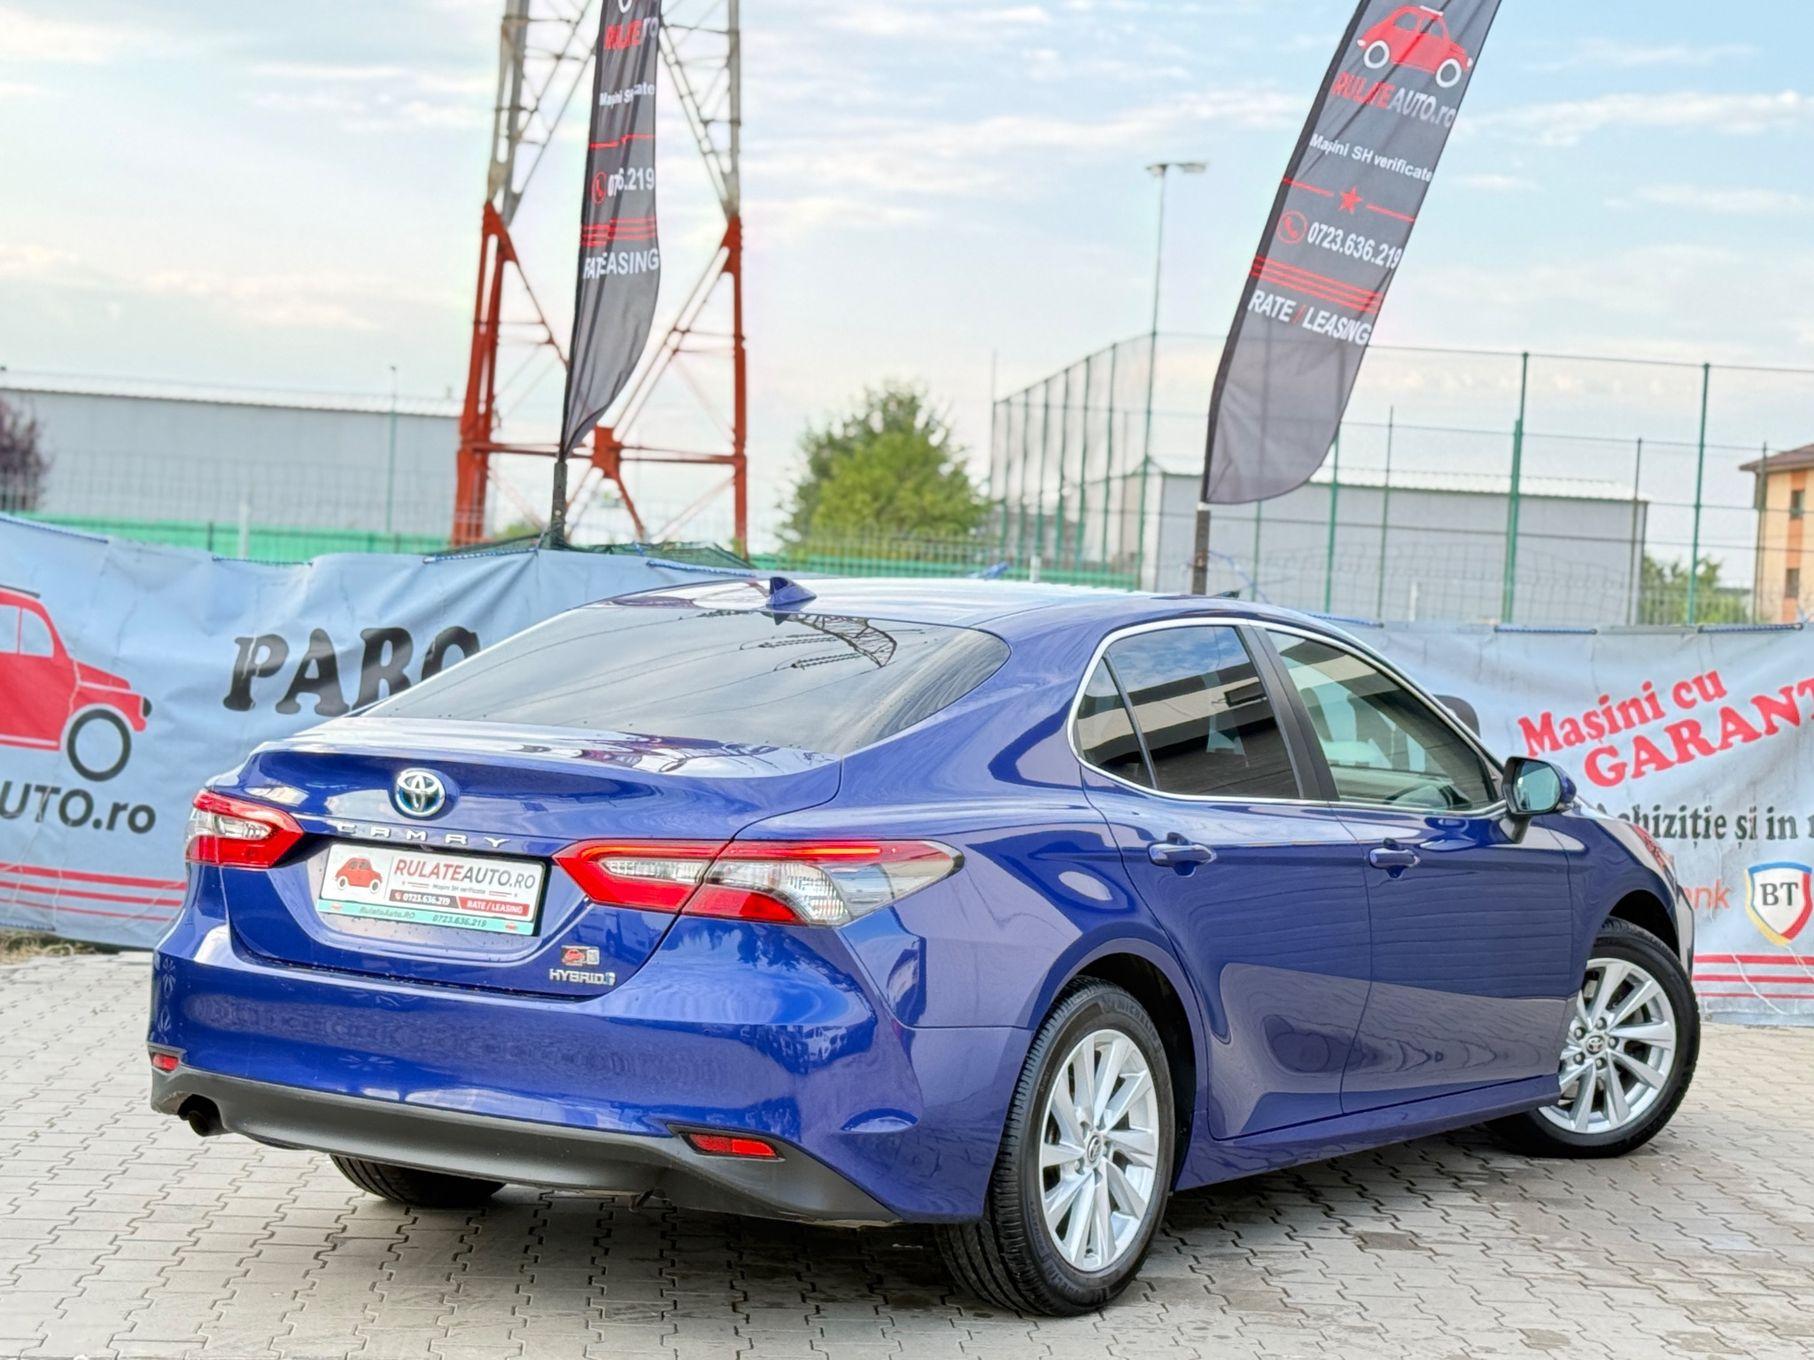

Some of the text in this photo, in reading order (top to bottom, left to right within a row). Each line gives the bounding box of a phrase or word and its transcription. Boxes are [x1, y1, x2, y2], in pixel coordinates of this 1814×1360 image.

[1351, 145, 1374, 164] SH
[1374, 153, 1433, 182] verificate
[1307, 221, 1402, 269] 0723.636.219
[1248, 290, 1297, 322] RATE
[1302, 306, 1372, 346] LEASING
[1672, 669, 1728, 710] cu
[337, 822, 511, 848] CAMRY
[1766, 806, 1799, 840] in
[394, 859, 536, 890] RULATEAUTO.RO
[1760, 881, 1799, 907] BT
[549, 968, 602, 985] HYBRID
